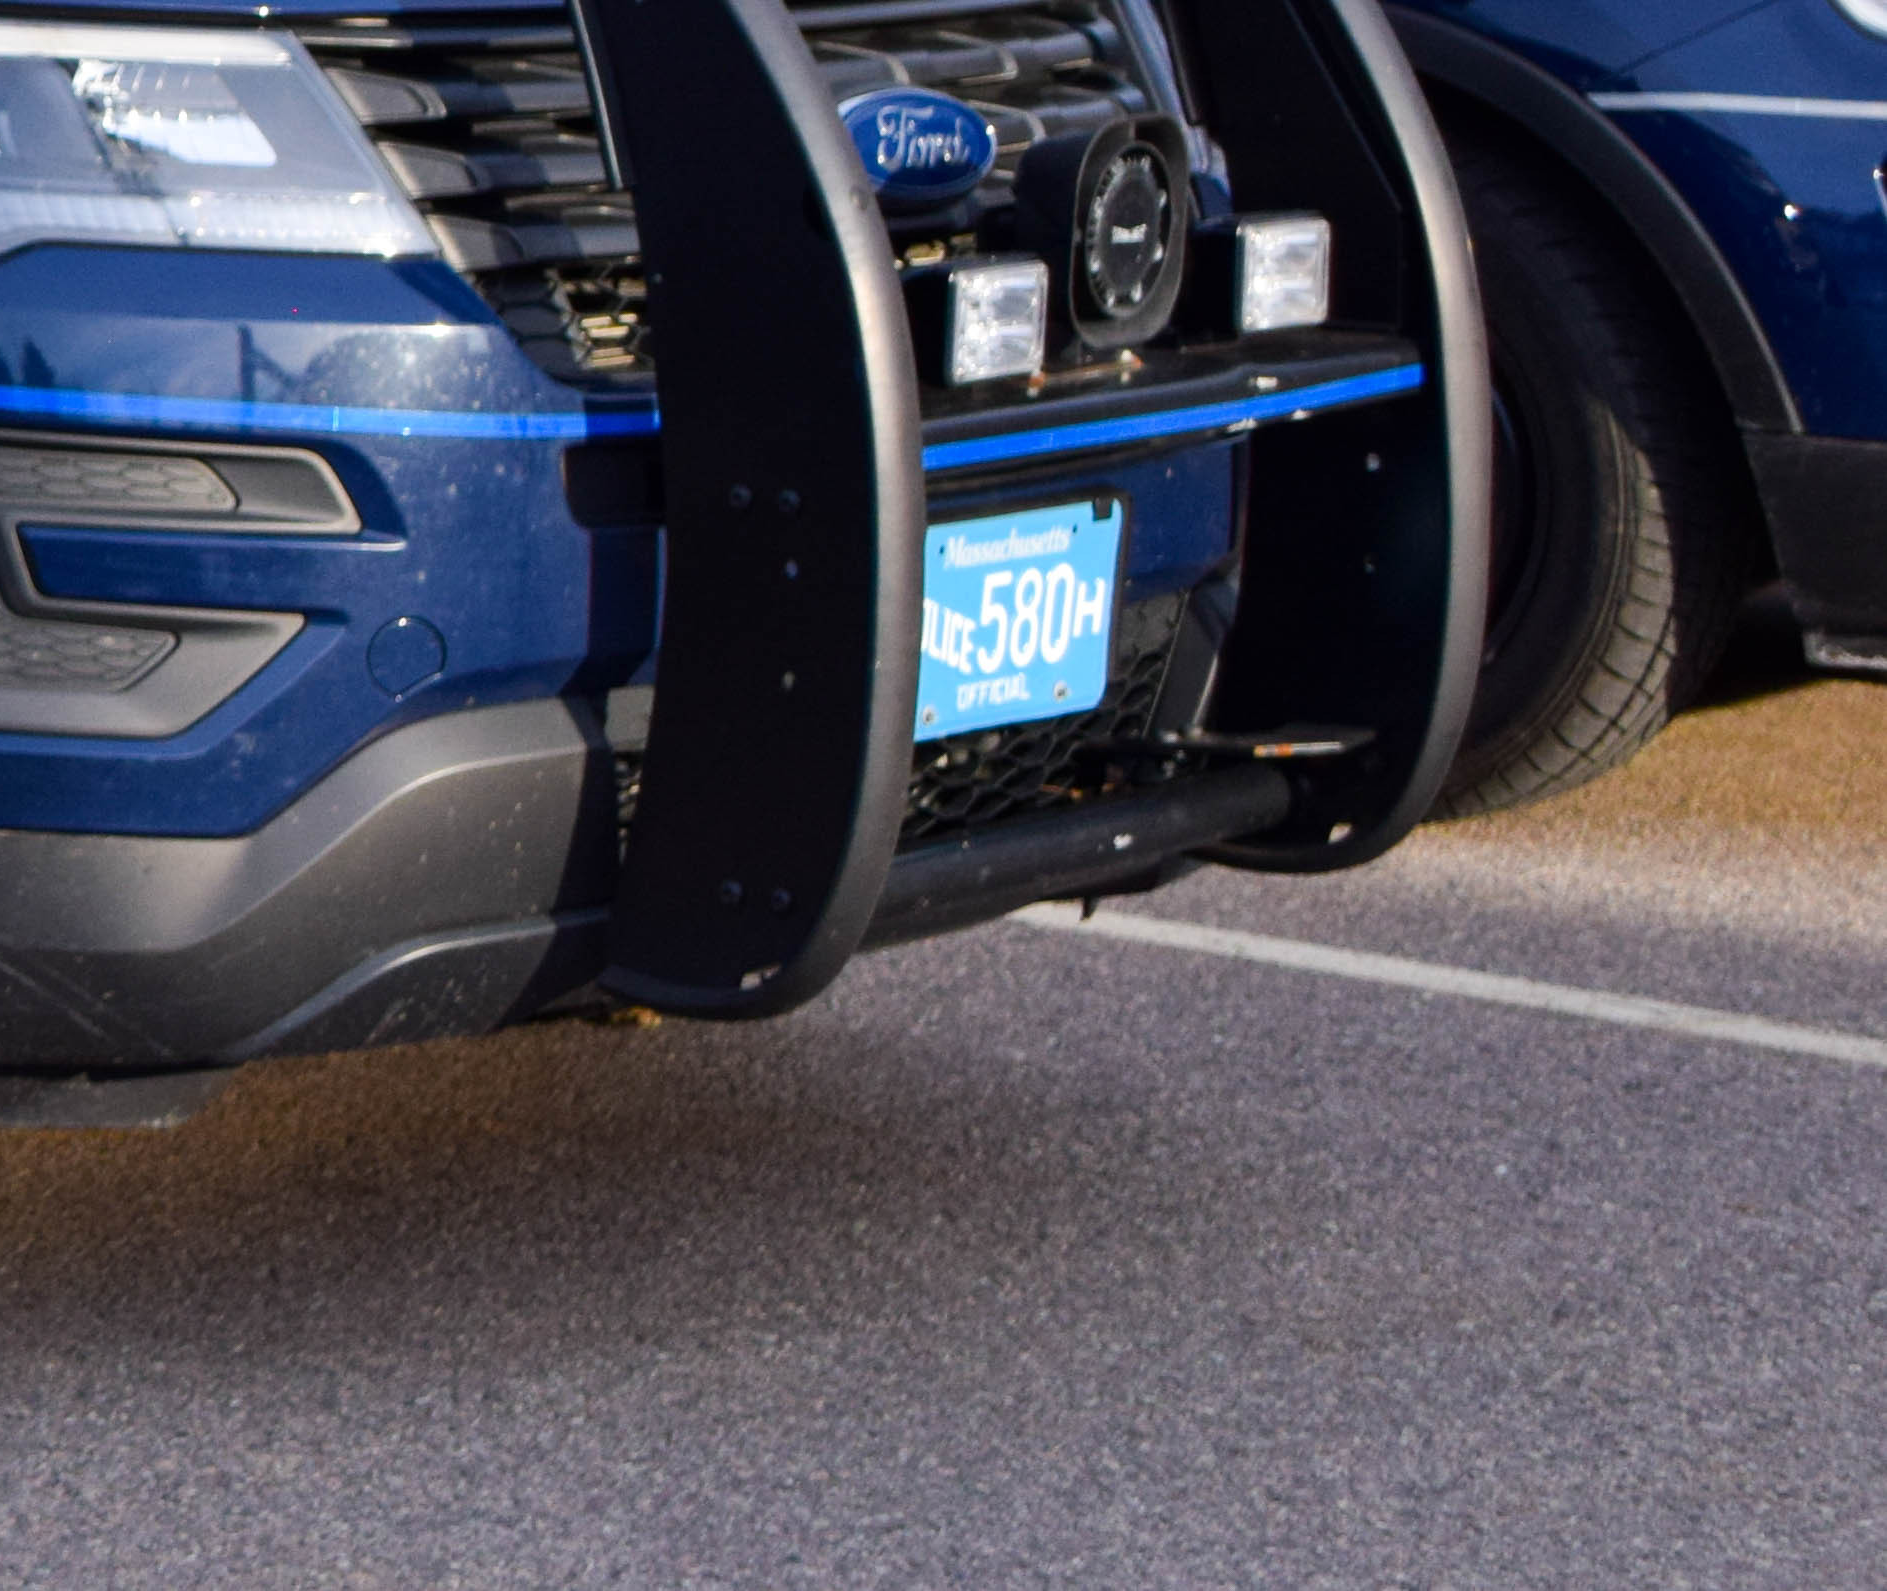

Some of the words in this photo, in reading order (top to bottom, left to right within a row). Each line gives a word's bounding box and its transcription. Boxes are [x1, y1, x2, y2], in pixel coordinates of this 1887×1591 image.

[877, 105, 972, 172] Ford
[943, 527, 1073, 569] Massachusetts
[956, 672, 1031, 711] OFFICIAL
